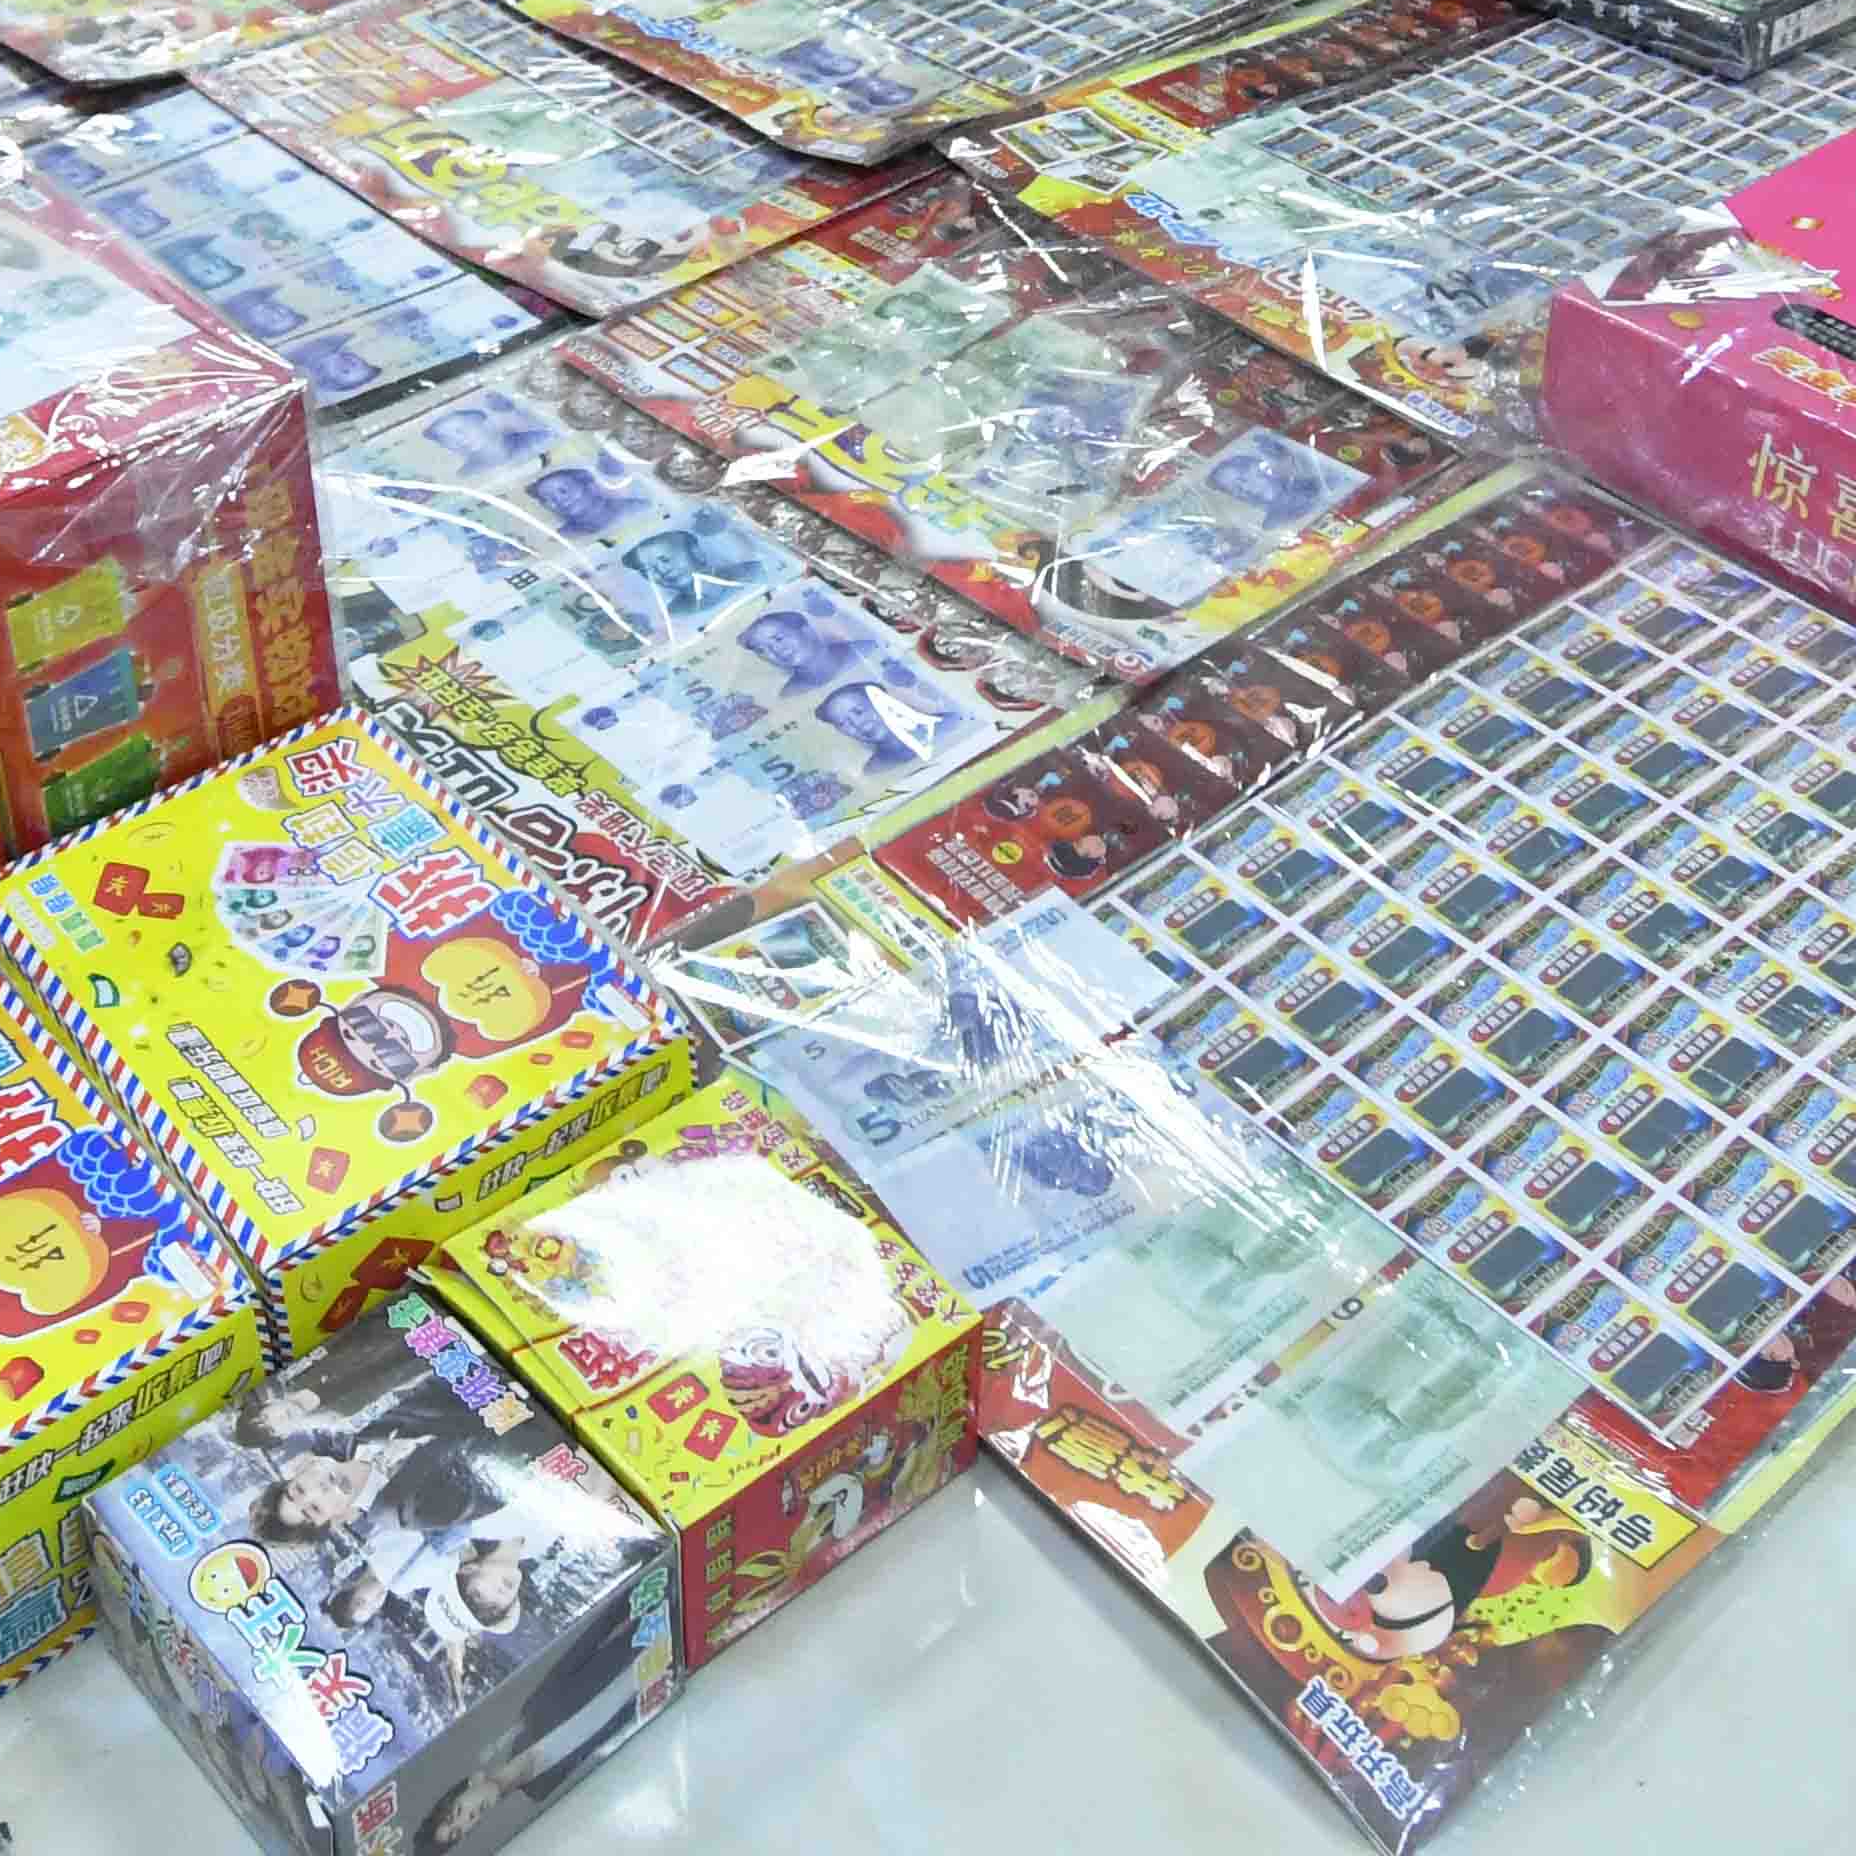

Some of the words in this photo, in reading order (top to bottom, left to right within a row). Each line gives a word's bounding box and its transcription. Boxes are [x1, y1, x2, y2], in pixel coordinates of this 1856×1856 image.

[355, 839, 511, 945] 拆
[300, 1043, 356, 1093] RICH
[1293, 1680, 1430, 1824] 高升玩具
